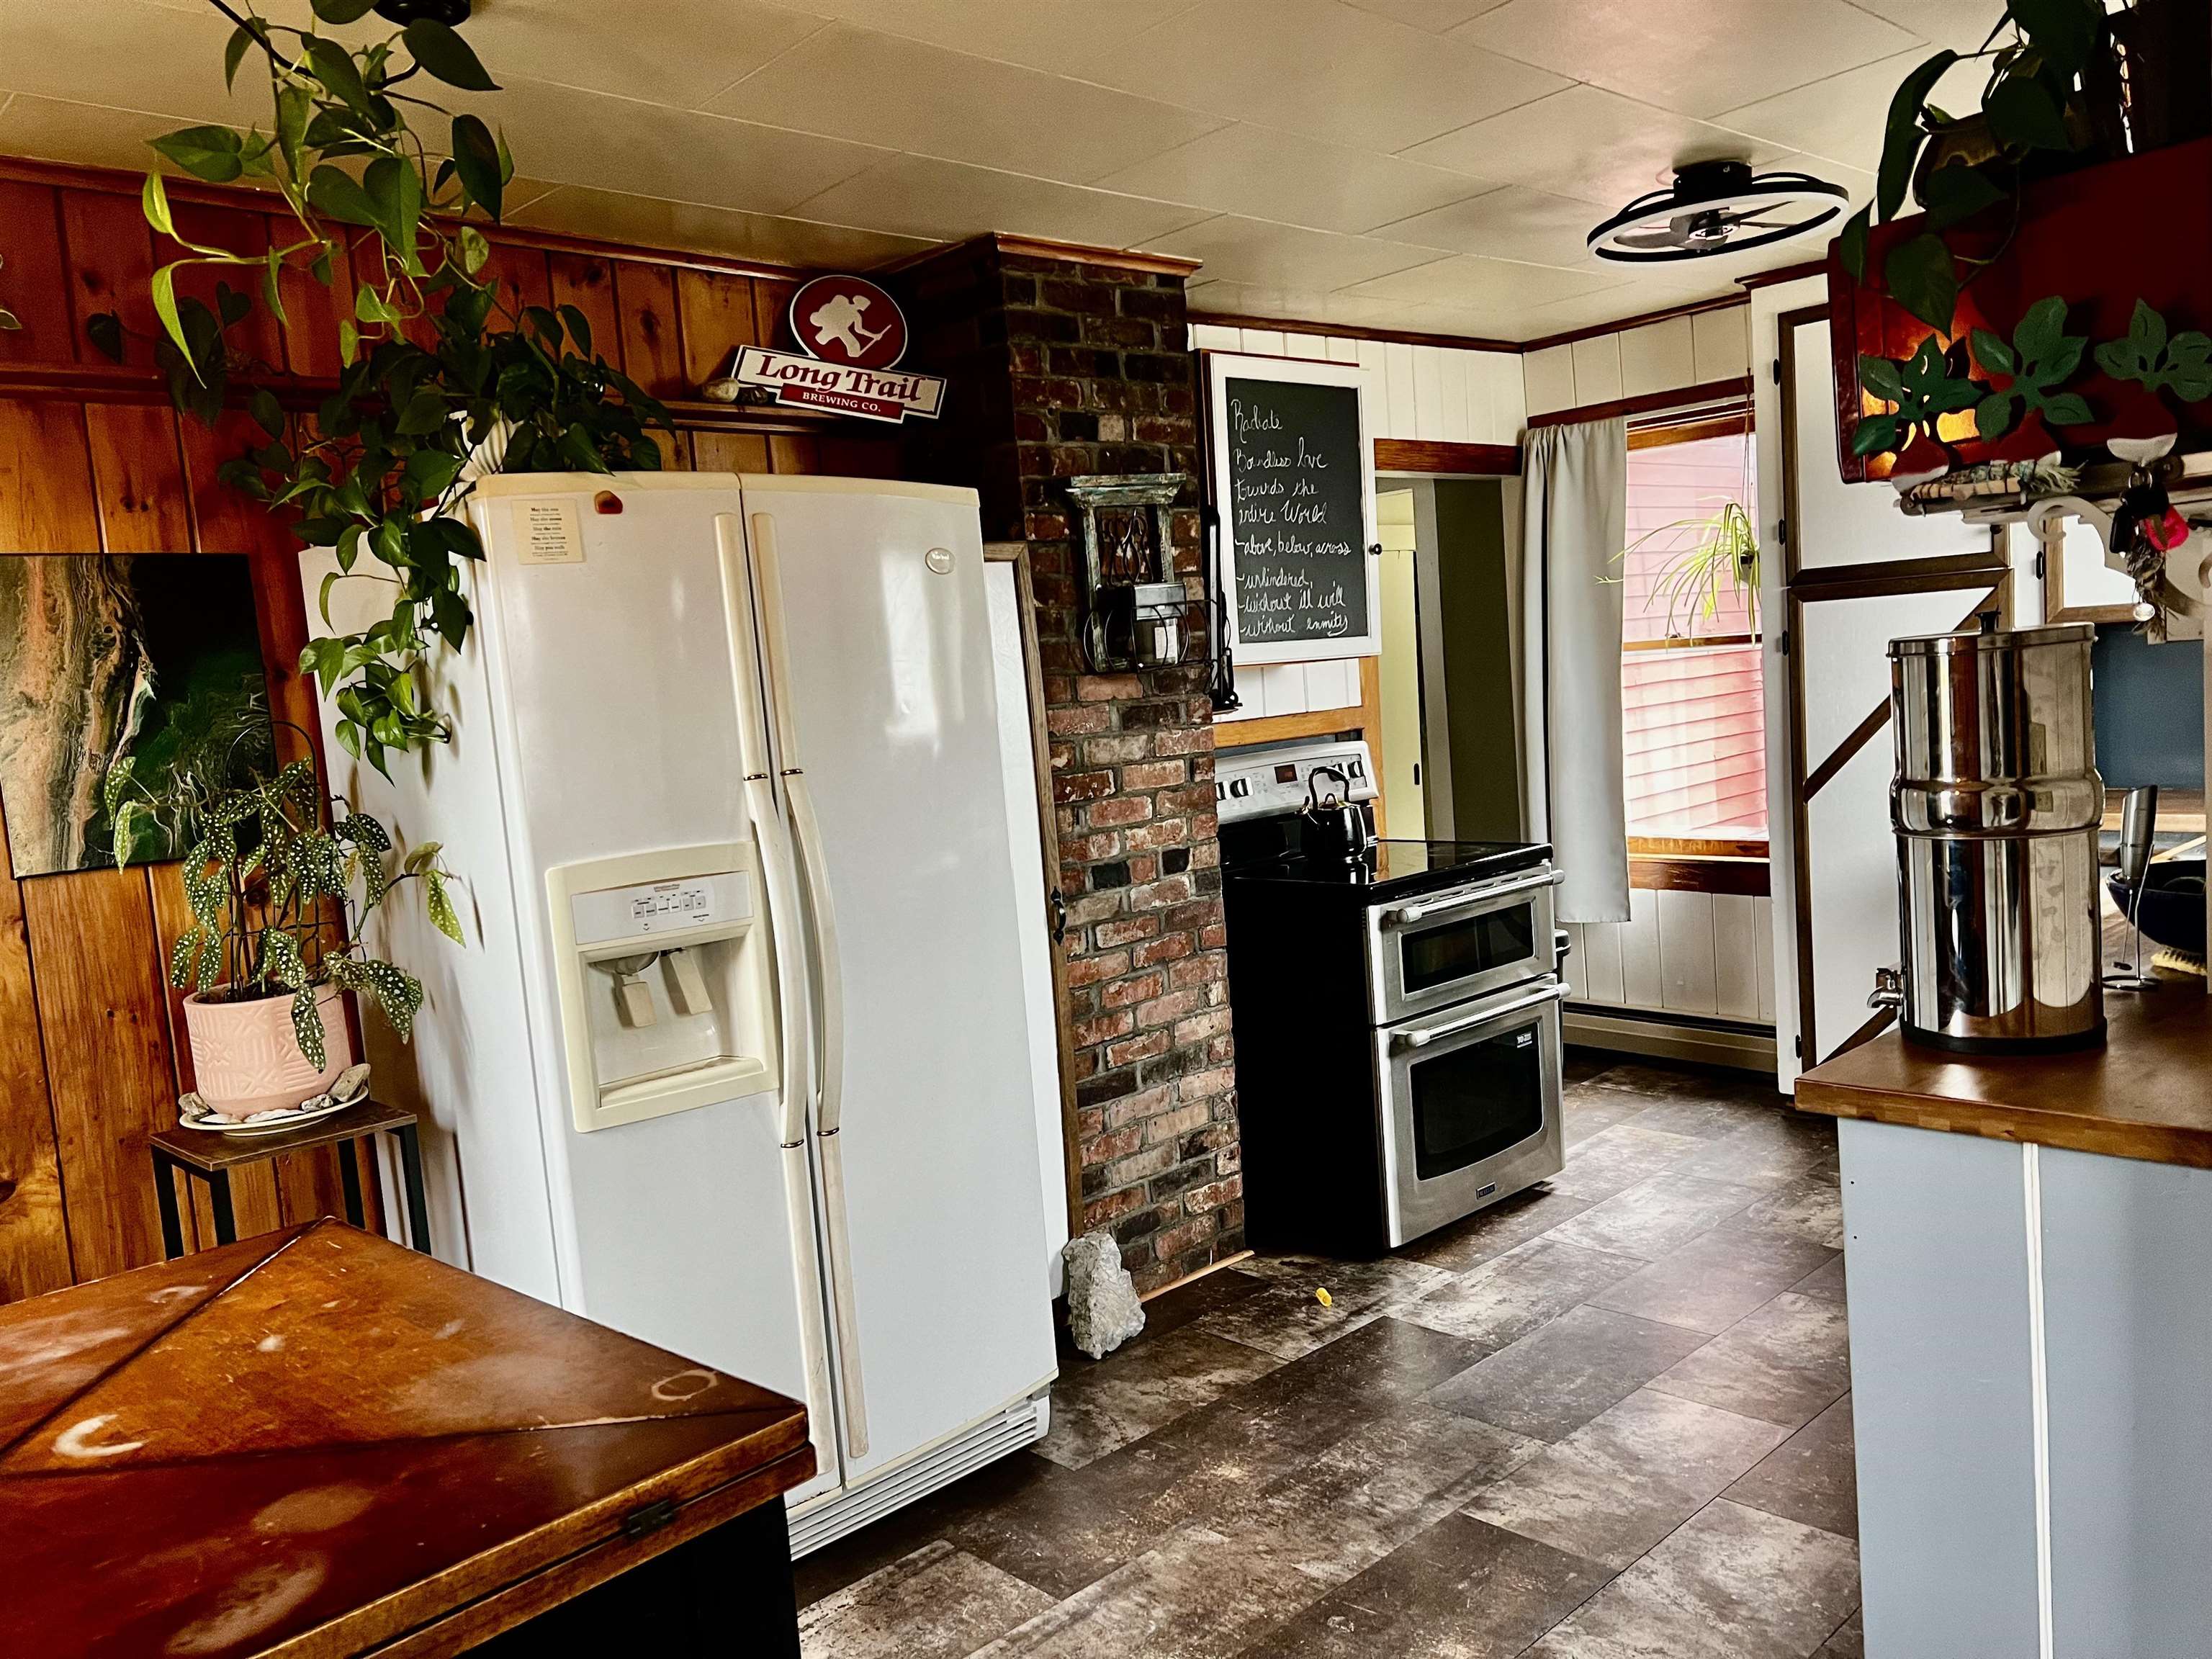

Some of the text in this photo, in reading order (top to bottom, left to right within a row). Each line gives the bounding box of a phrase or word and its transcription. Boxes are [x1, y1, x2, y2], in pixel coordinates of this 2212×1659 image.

[756, 354, 927, 402] Long Trail
[802, 391, 881, 413] BREWING CO.
[1231, 399, 1283, 444] Radiate
[1233, 436, 1329, 473] Boundless love
[1234, 477, 1320, 503] towards the
[1238, 502, 1277, 526] entire
[1277, 530, 1313, 558] below,
[1315, 541, 1352, 556] across
[1298, 588, 1314, 611] ill
[1318, 580, 1346, 610] will
[1306, 610, 1349, 637] enmity
